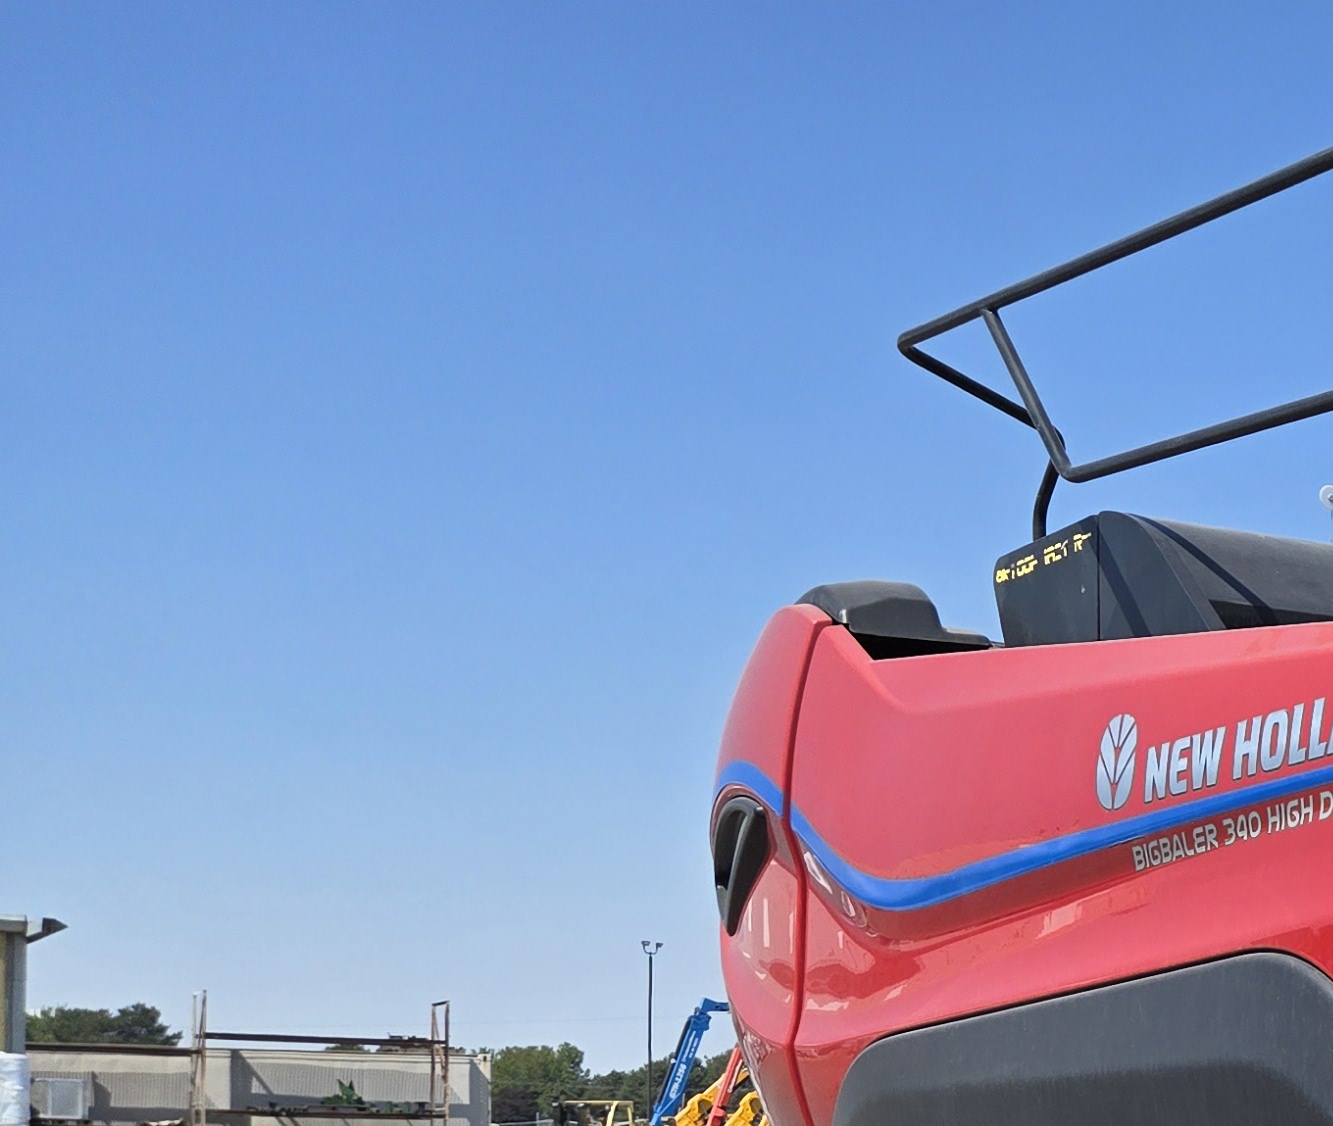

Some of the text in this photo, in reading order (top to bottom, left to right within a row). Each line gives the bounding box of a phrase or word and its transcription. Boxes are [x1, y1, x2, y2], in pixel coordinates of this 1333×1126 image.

[1144, 726, 1227, 804] NEW
[1131, 823, 1219, 872] BIGBALER
[1222, 811, 1262, 846] 340
[1266, 795, 1315, 834] HIGH
